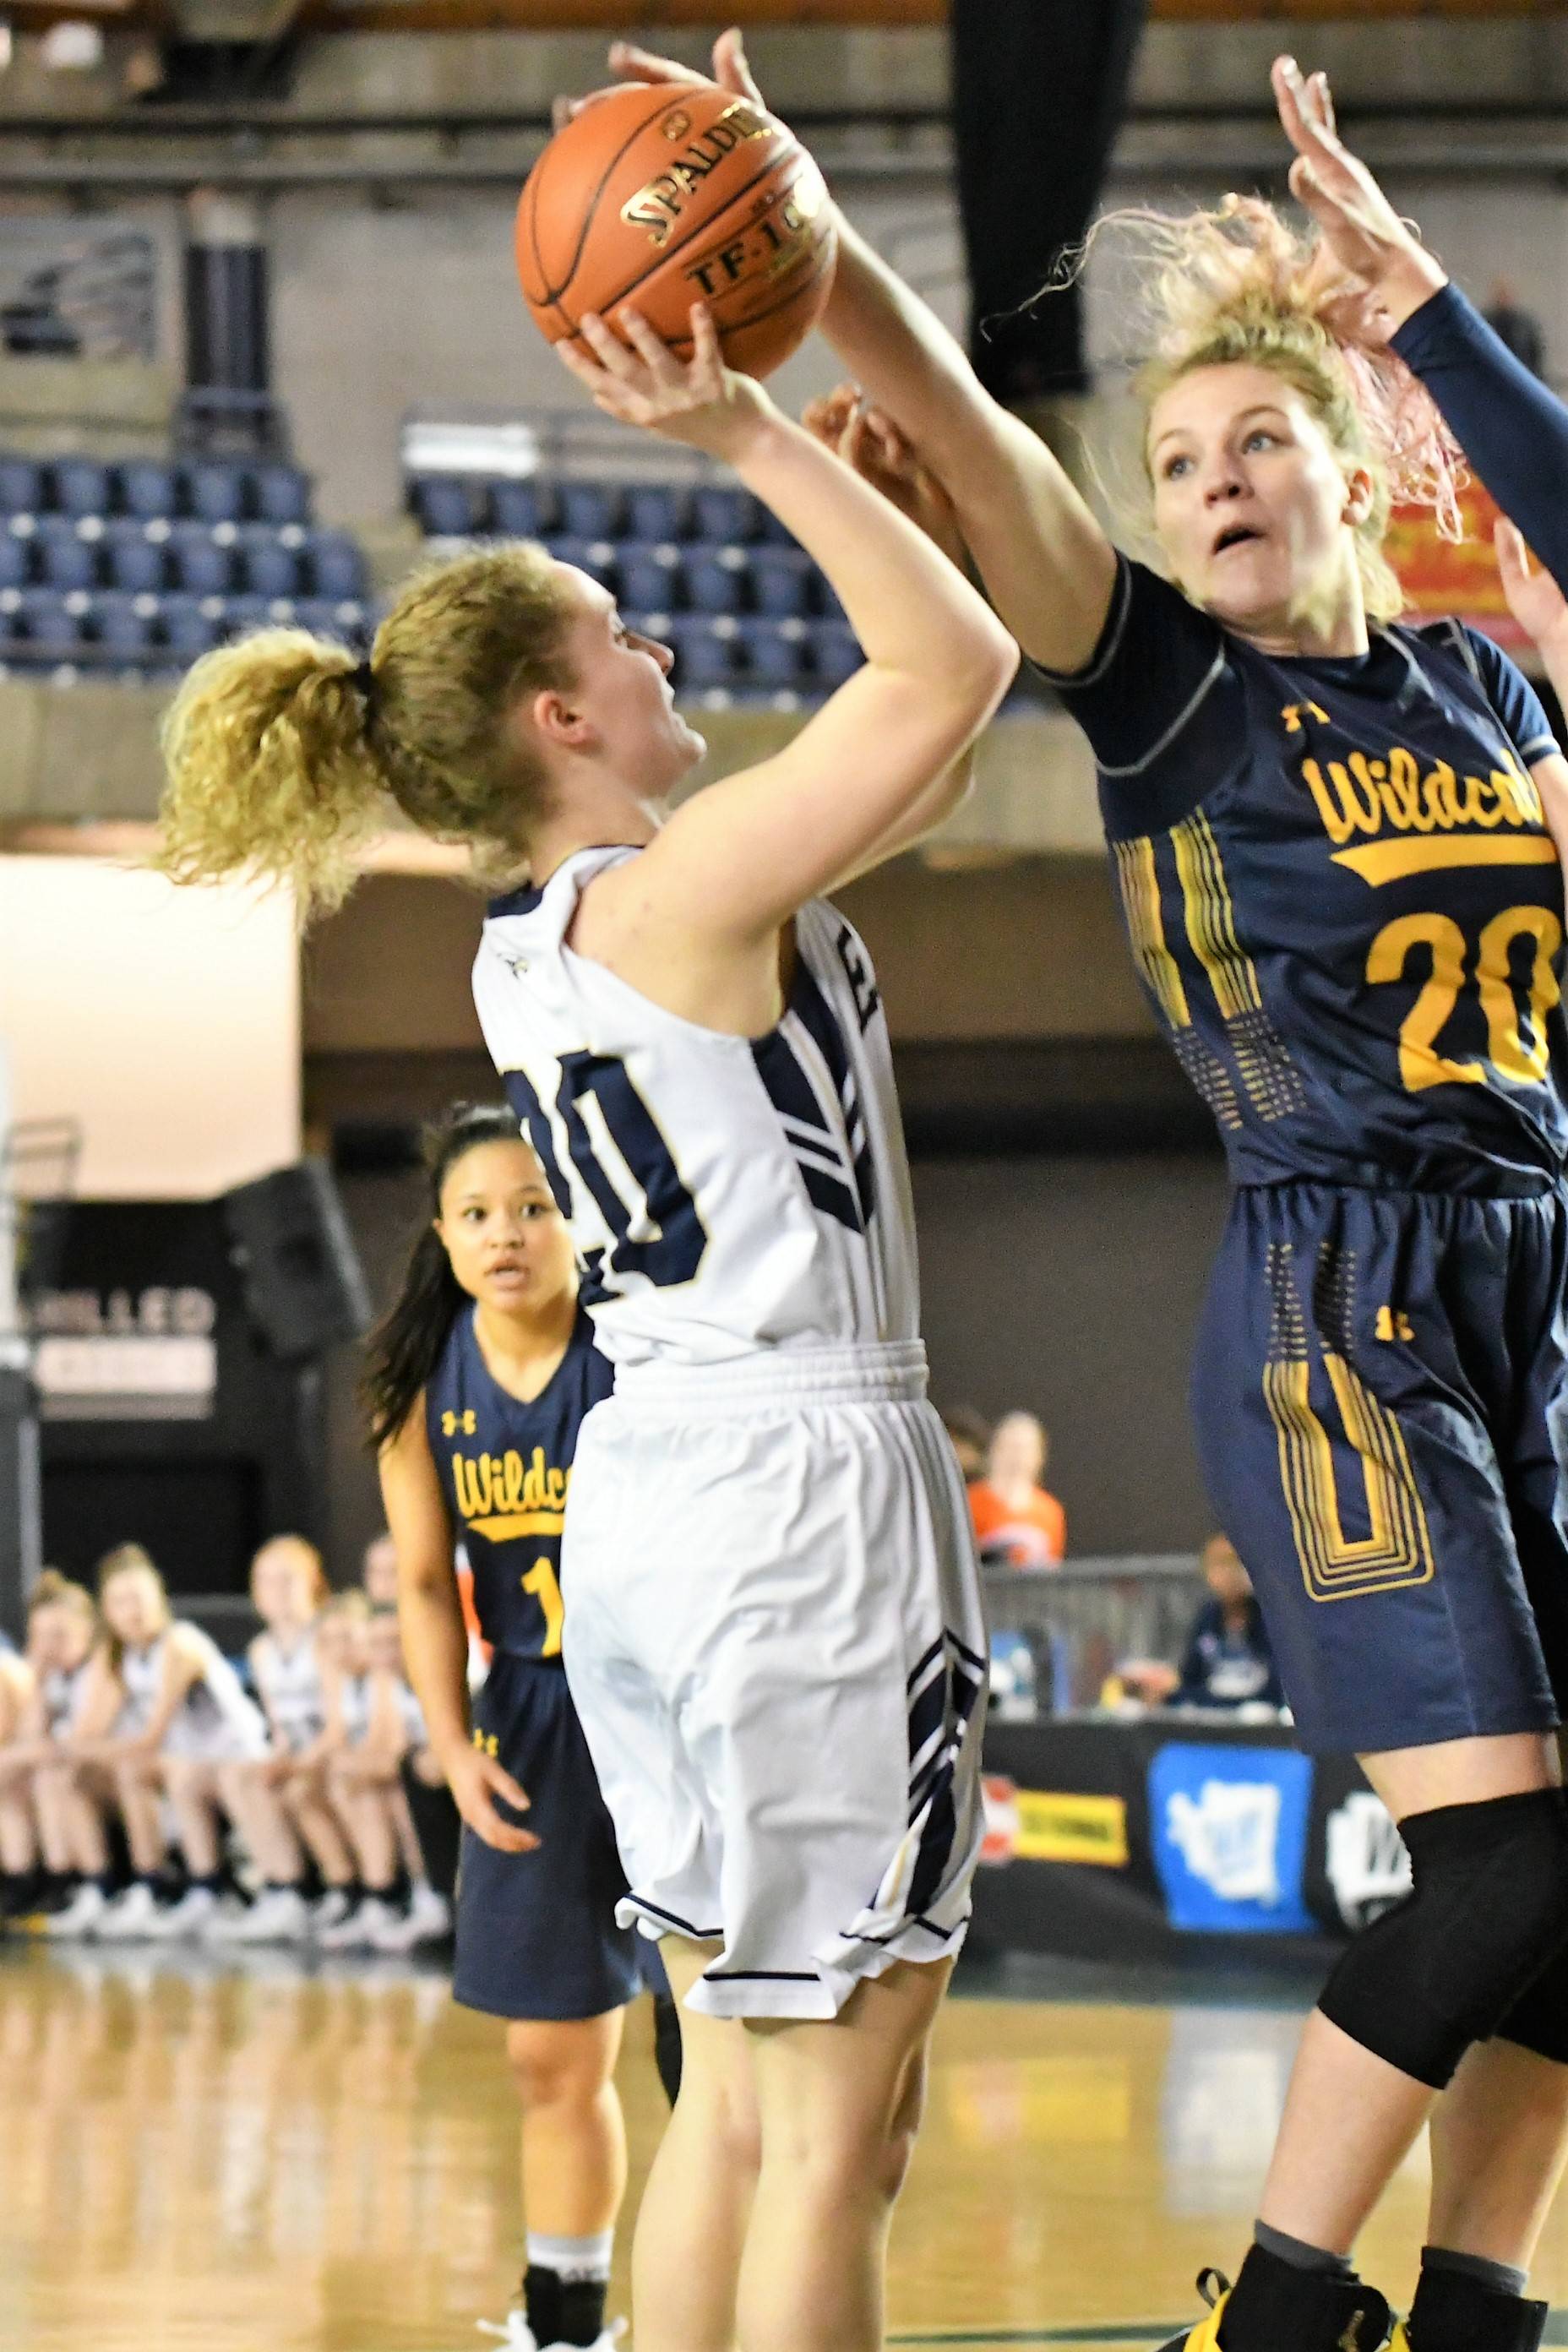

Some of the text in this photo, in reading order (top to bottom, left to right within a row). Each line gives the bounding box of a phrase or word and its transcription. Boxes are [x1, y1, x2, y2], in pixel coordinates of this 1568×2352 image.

[1365, 905, 1561, 1093] 20
[452, 1446, 572, 1518] Wildc
[520, 1556, 565, 1658] 1
